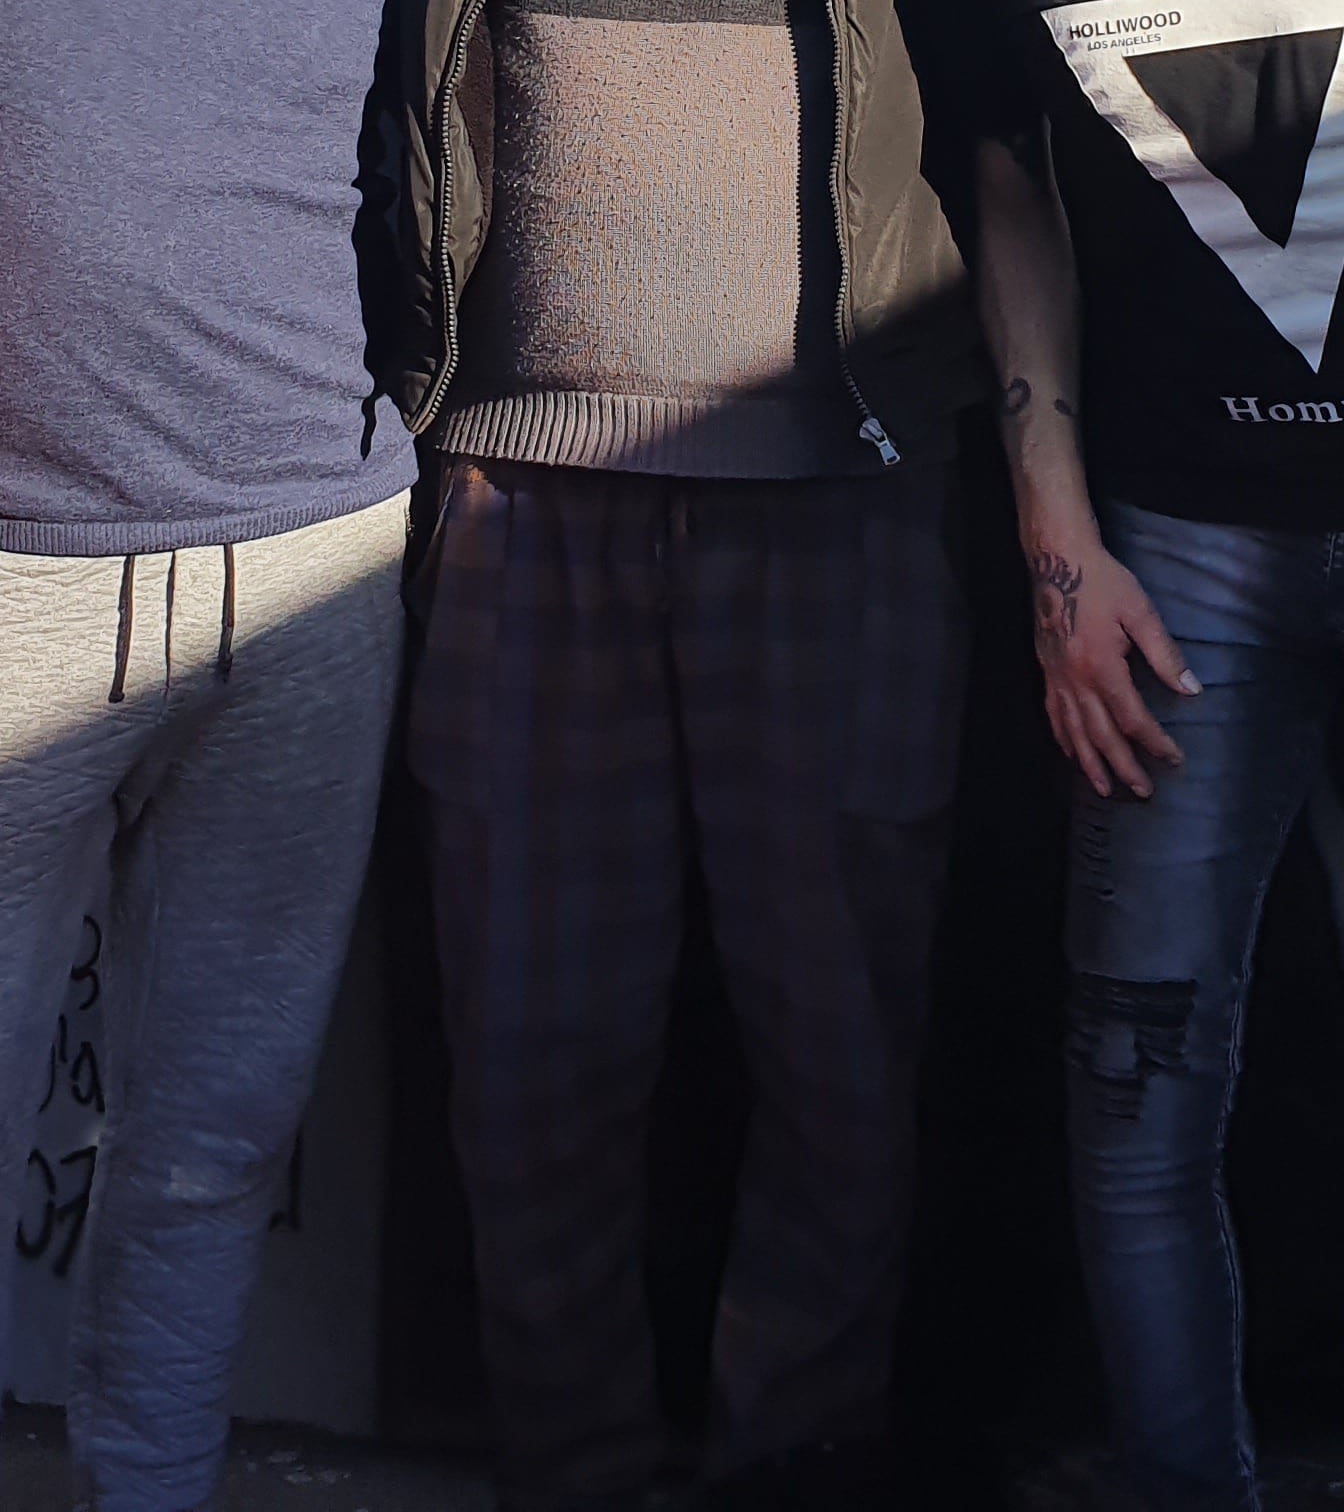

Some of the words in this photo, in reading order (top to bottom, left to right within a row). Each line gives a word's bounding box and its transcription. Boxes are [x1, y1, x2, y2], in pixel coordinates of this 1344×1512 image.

[1068, 10, 1182, 40] HOLLIWOOD
[1087, 39, 1109, 52] LOS
[1110, 33, 1162, 49] ANGELES
